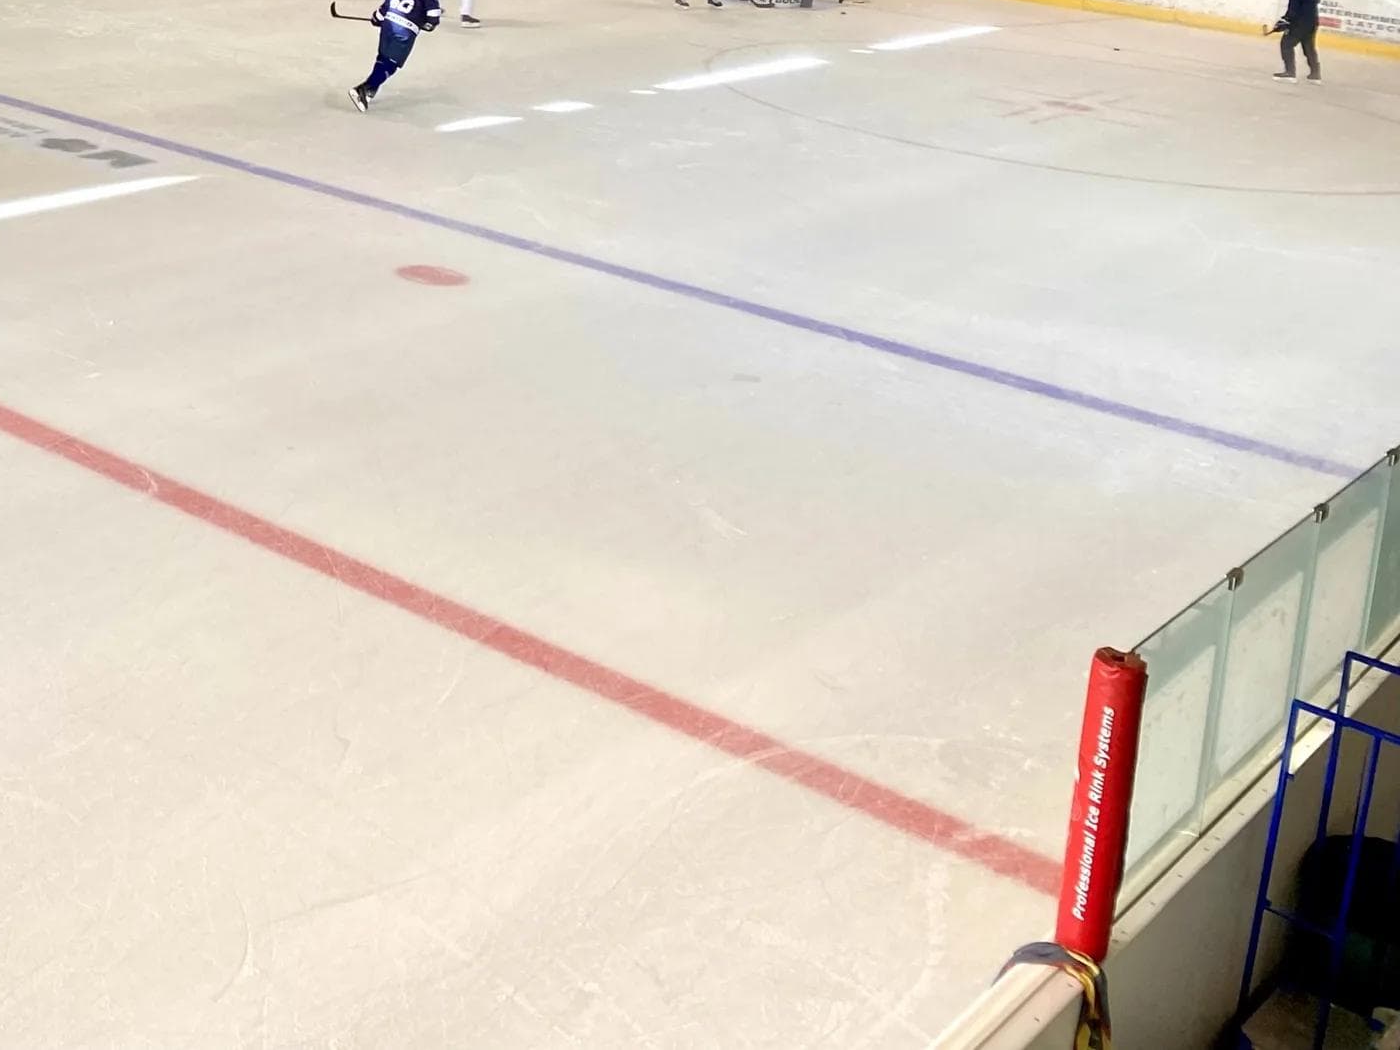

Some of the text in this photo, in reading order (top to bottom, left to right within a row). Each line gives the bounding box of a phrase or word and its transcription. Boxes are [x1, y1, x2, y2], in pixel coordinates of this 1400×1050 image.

[1071, 706, 1116, 923] Professional Ice Rink Systems
